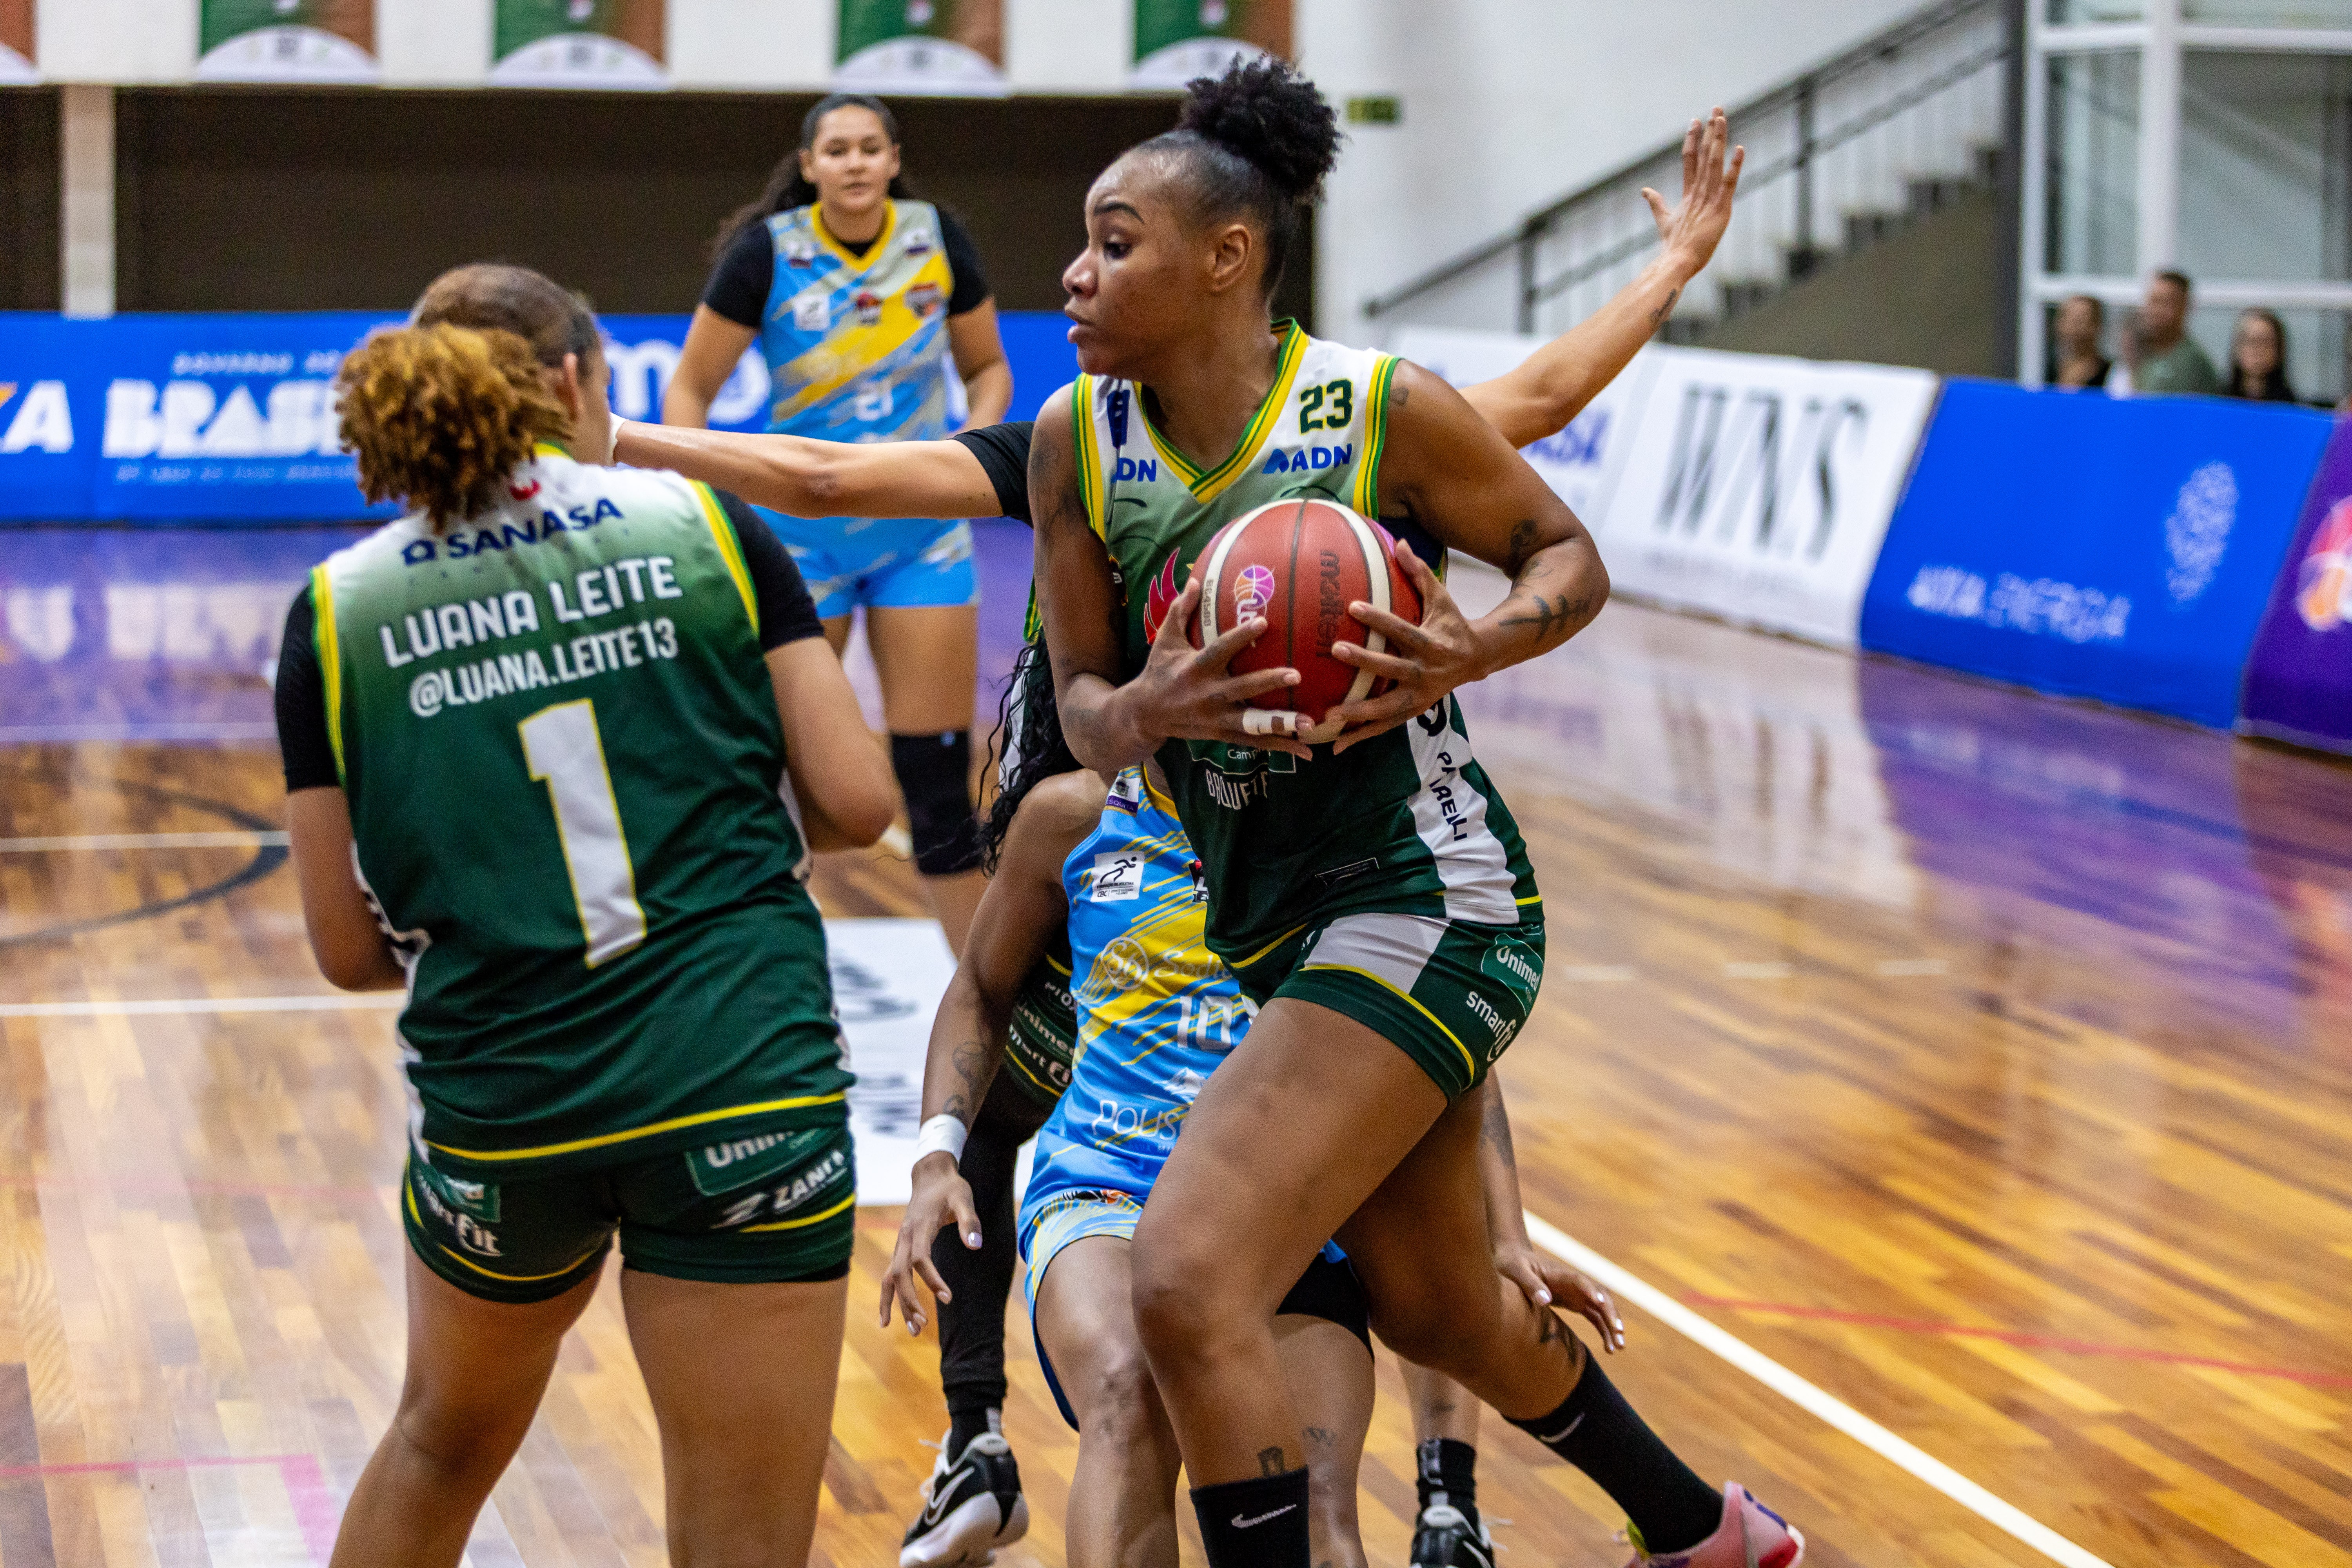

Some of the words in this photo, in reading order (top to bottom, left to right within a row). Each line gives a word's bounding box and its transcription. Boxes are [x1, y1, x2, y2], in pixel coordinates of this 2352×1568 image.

[1299, 378, 1353, 436] 23
[1111, 457, 1156, 482] DN
[1291, 443, 1352, 473] ADN
[446, 497, 624, 559] SANASA
[379, 590, 540, 669] LUANA
[549, 555, 683, 623] LEITE
[518, 698, 648, 969] 1
[1177, 995, 1233, 1051] 10
